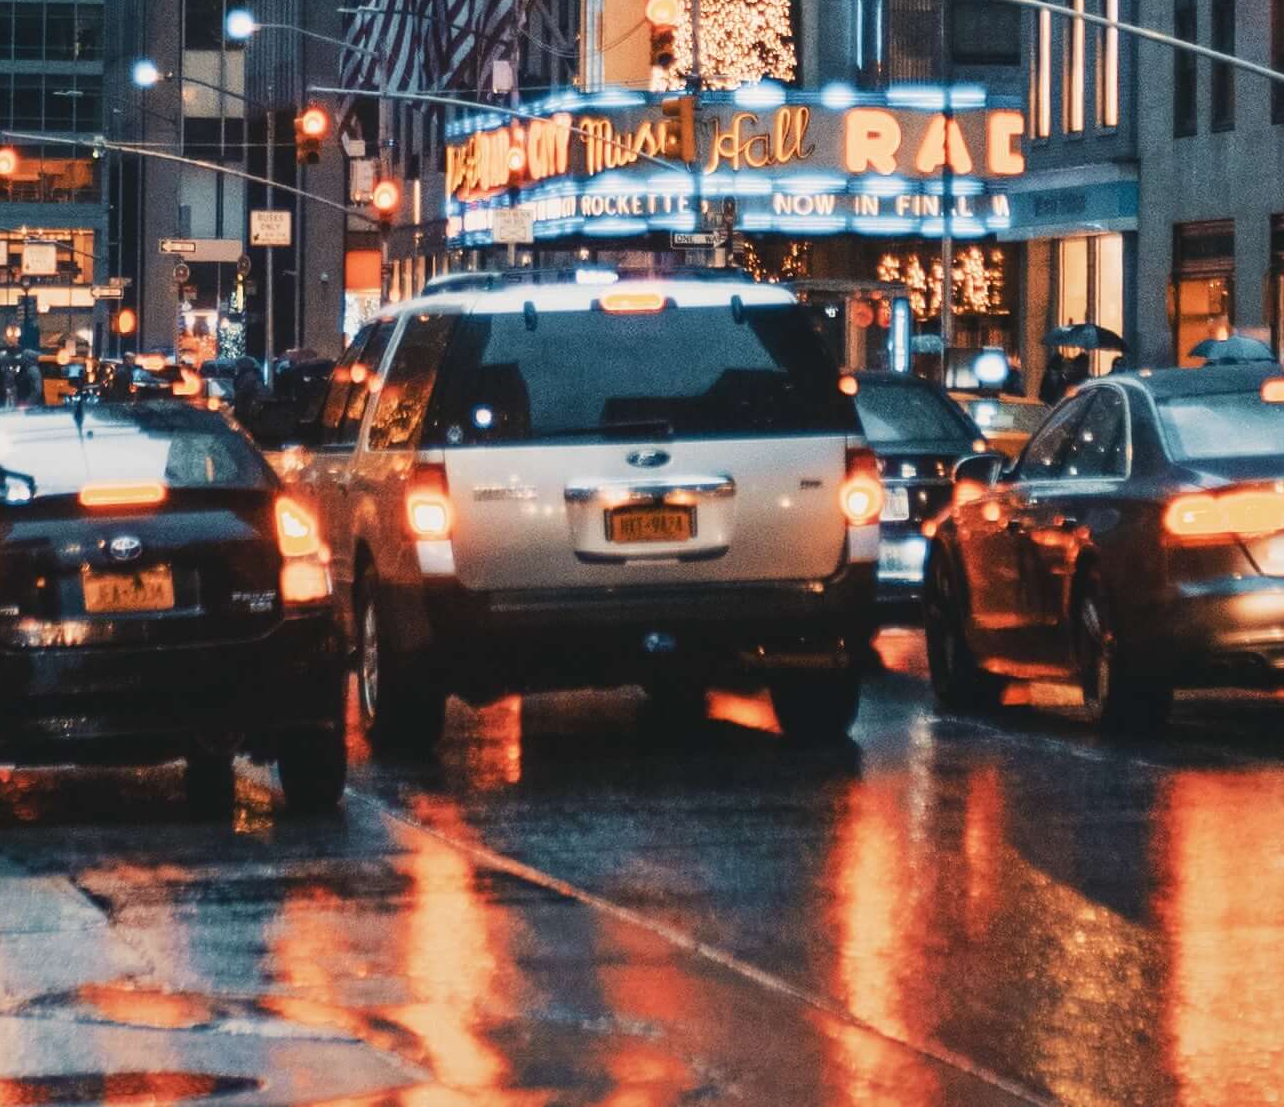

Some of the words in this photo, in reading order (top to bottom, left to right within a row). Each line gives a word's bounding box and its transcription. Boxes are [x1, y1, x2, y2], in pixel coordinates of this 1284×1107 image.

[579, 116, 677, 176] Musi
[704, 106, 815, 176] Hall
[773, 193, 835, 216] NOW
[854, 194, 879, 216] IN
[896, 194, 973, 217] FINL
